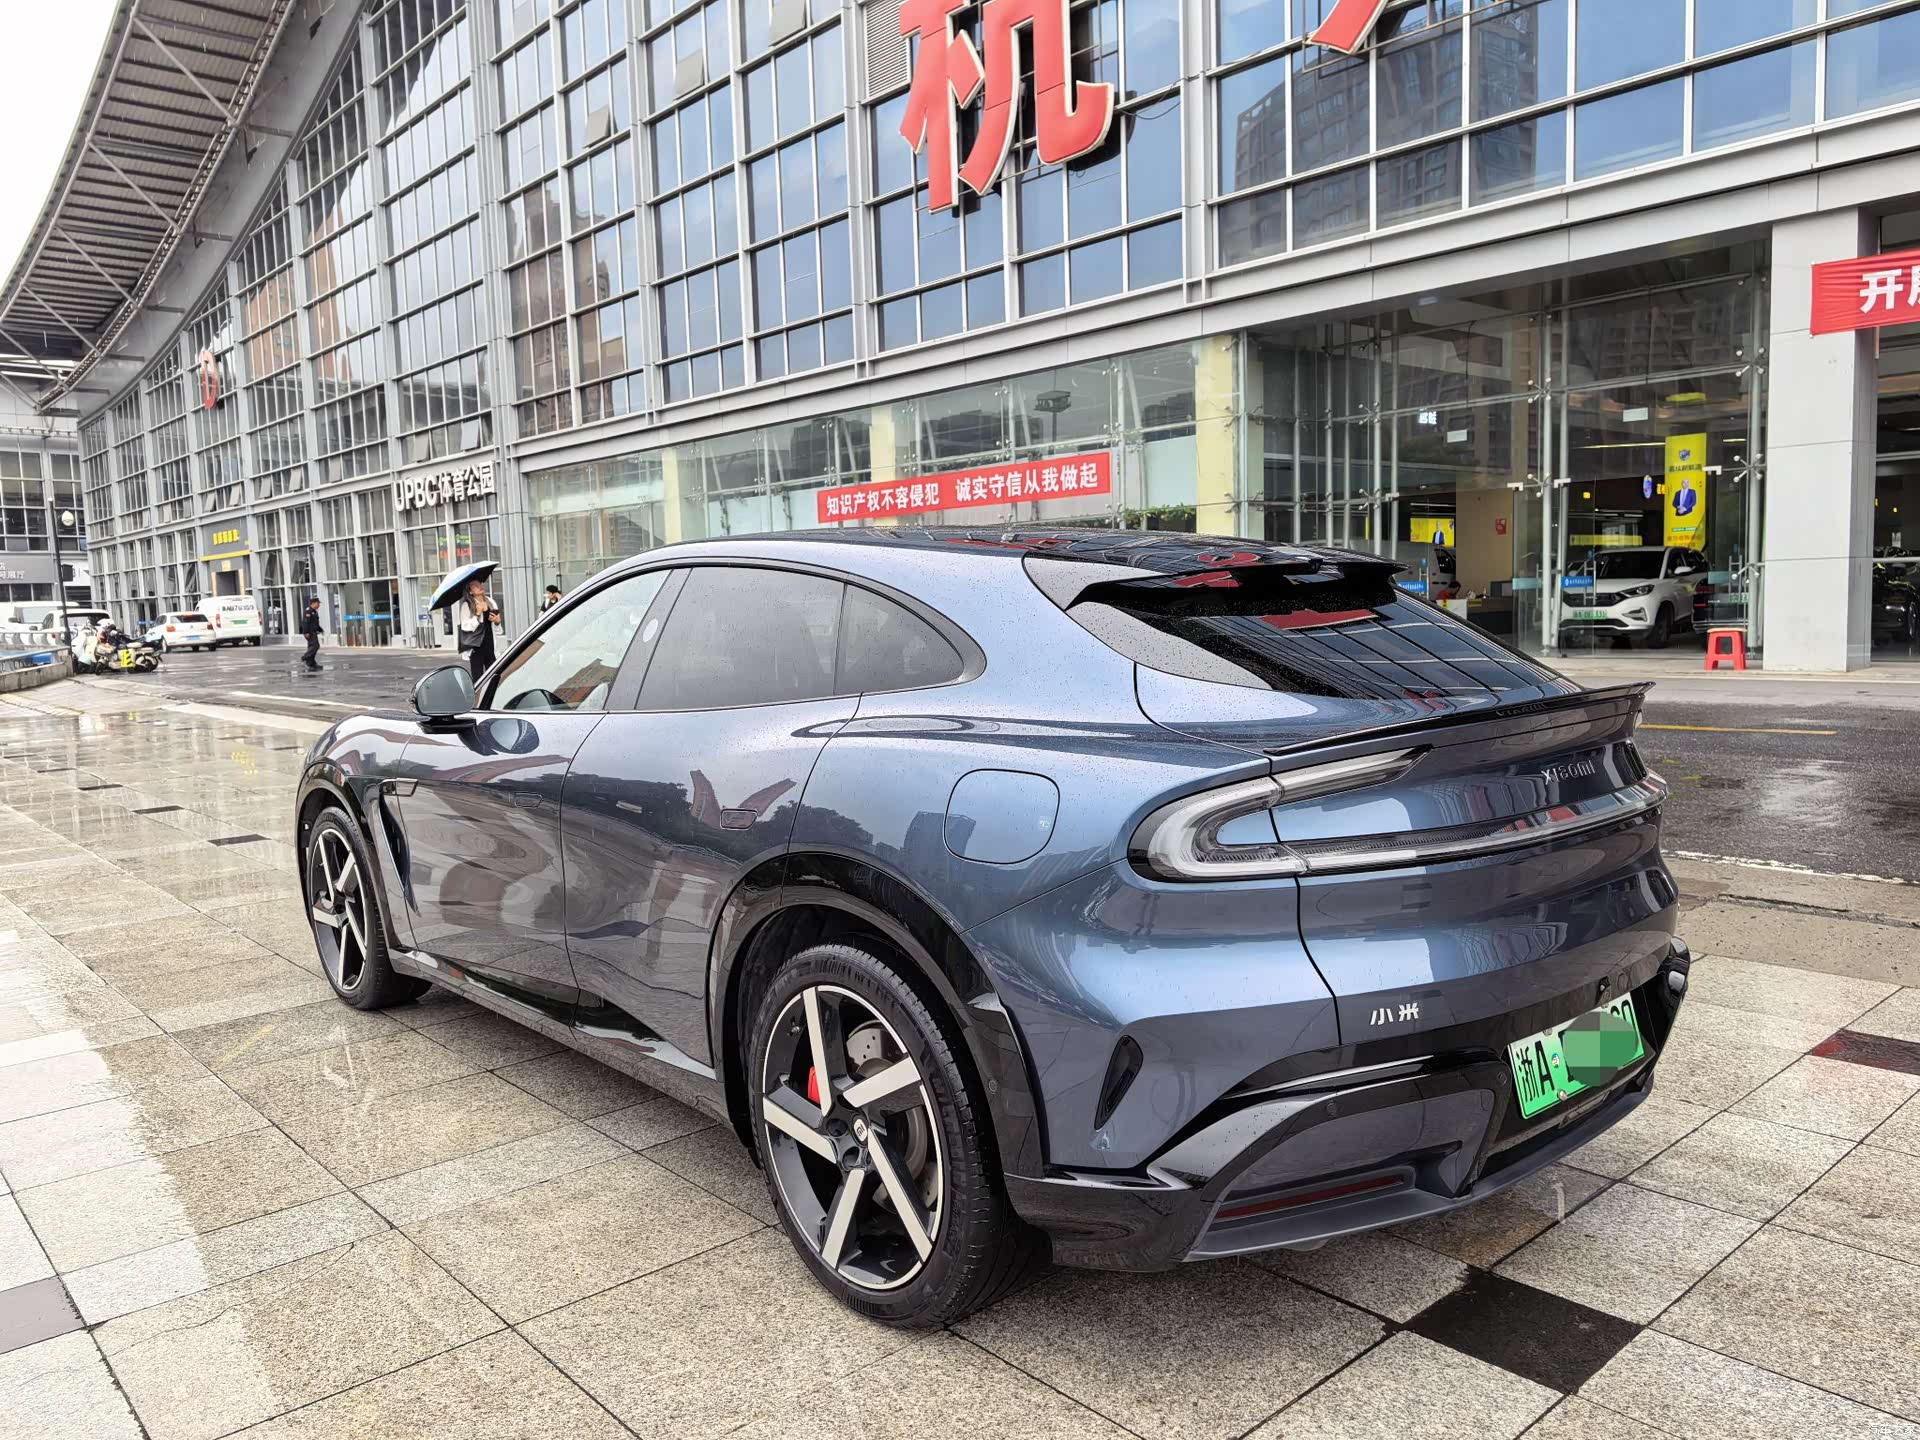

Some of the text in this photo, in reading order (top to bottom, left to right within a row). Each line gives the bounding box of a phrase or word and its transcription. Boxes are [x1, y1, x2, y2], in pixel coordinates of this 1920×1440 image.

[826, 462, 1099, 517] 知识产权不容侵犯 诚实守信从我做起
[1369, 1002, 1419, 1026] 小米
